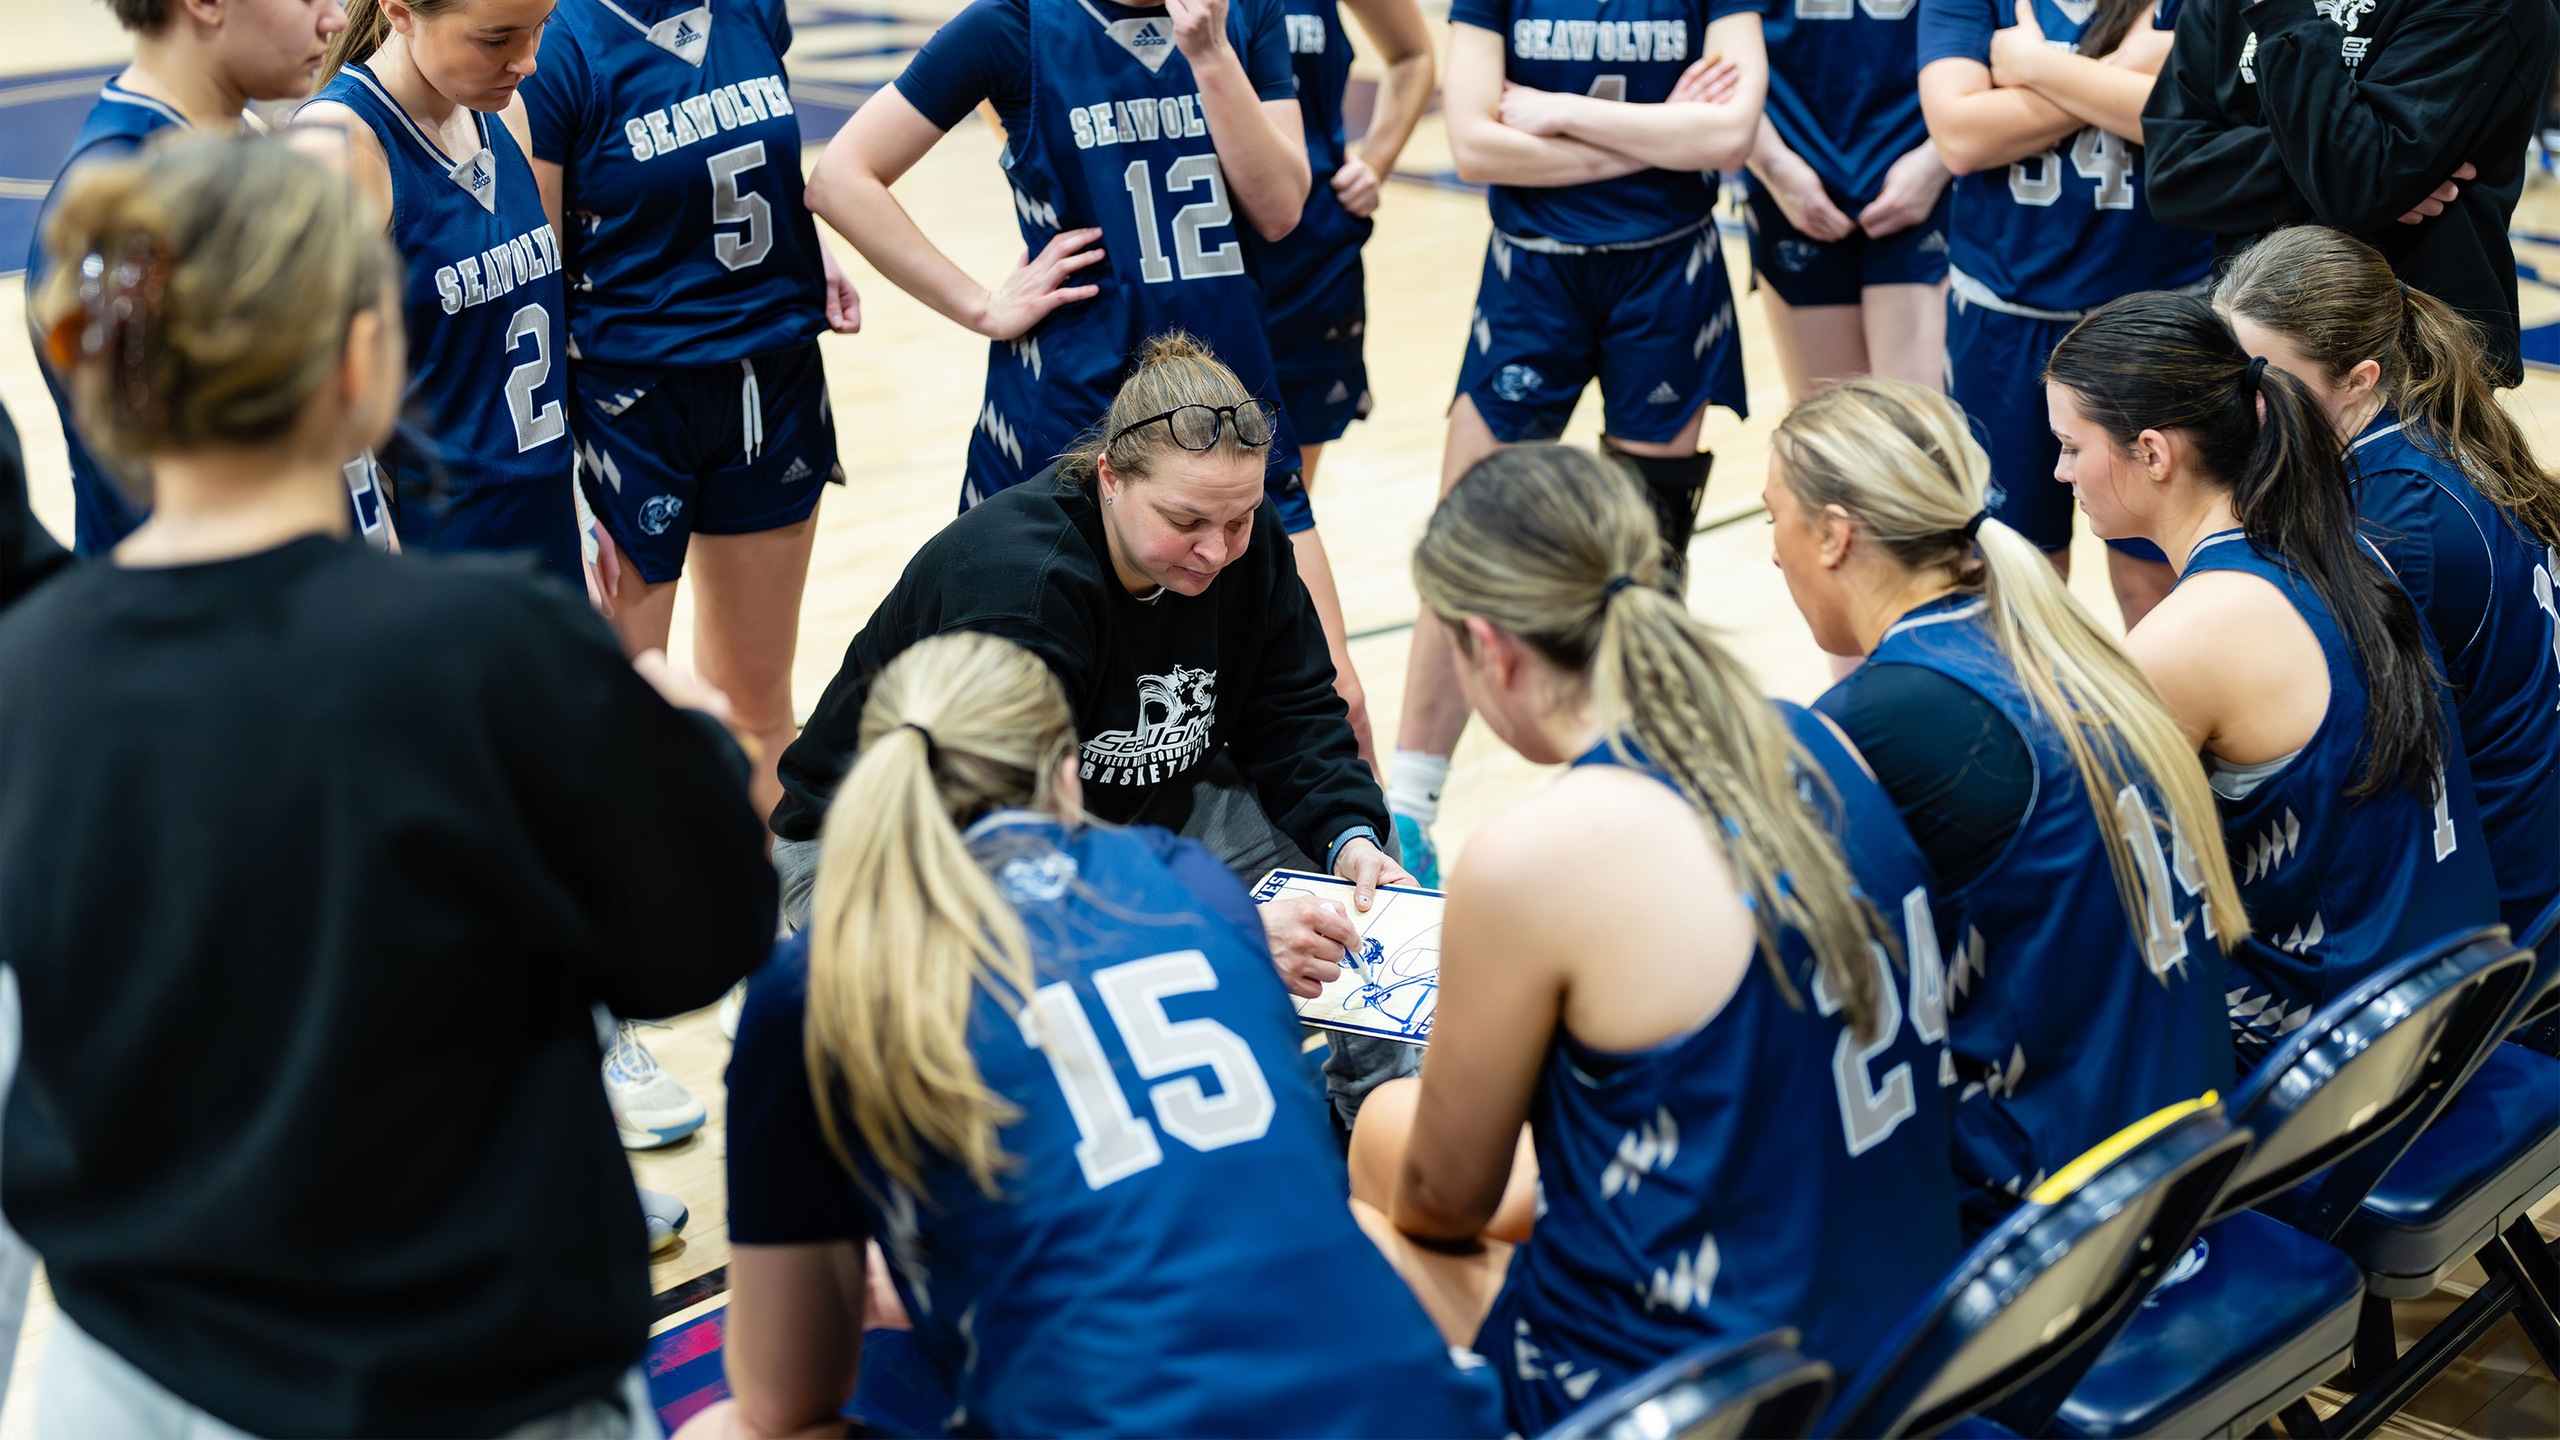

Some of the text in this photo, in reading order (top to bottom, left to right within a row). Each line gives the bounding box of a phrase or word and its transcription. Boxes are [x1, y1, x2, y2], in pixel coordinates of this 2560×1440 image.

[1514, 18, 1688, 62] SEAWOLVES
[624, 74, 794, 162] SEAWOLVES
[471, 175, 492, 191] adidas
[706, 140, 775, 272] 5
[1124, 154, 1246, 283] 12
[504, 302, 565, 454] 2
[1079, 746, 1130, 768] OUTHERN
[1019, 948, 1277, 1191] 15
